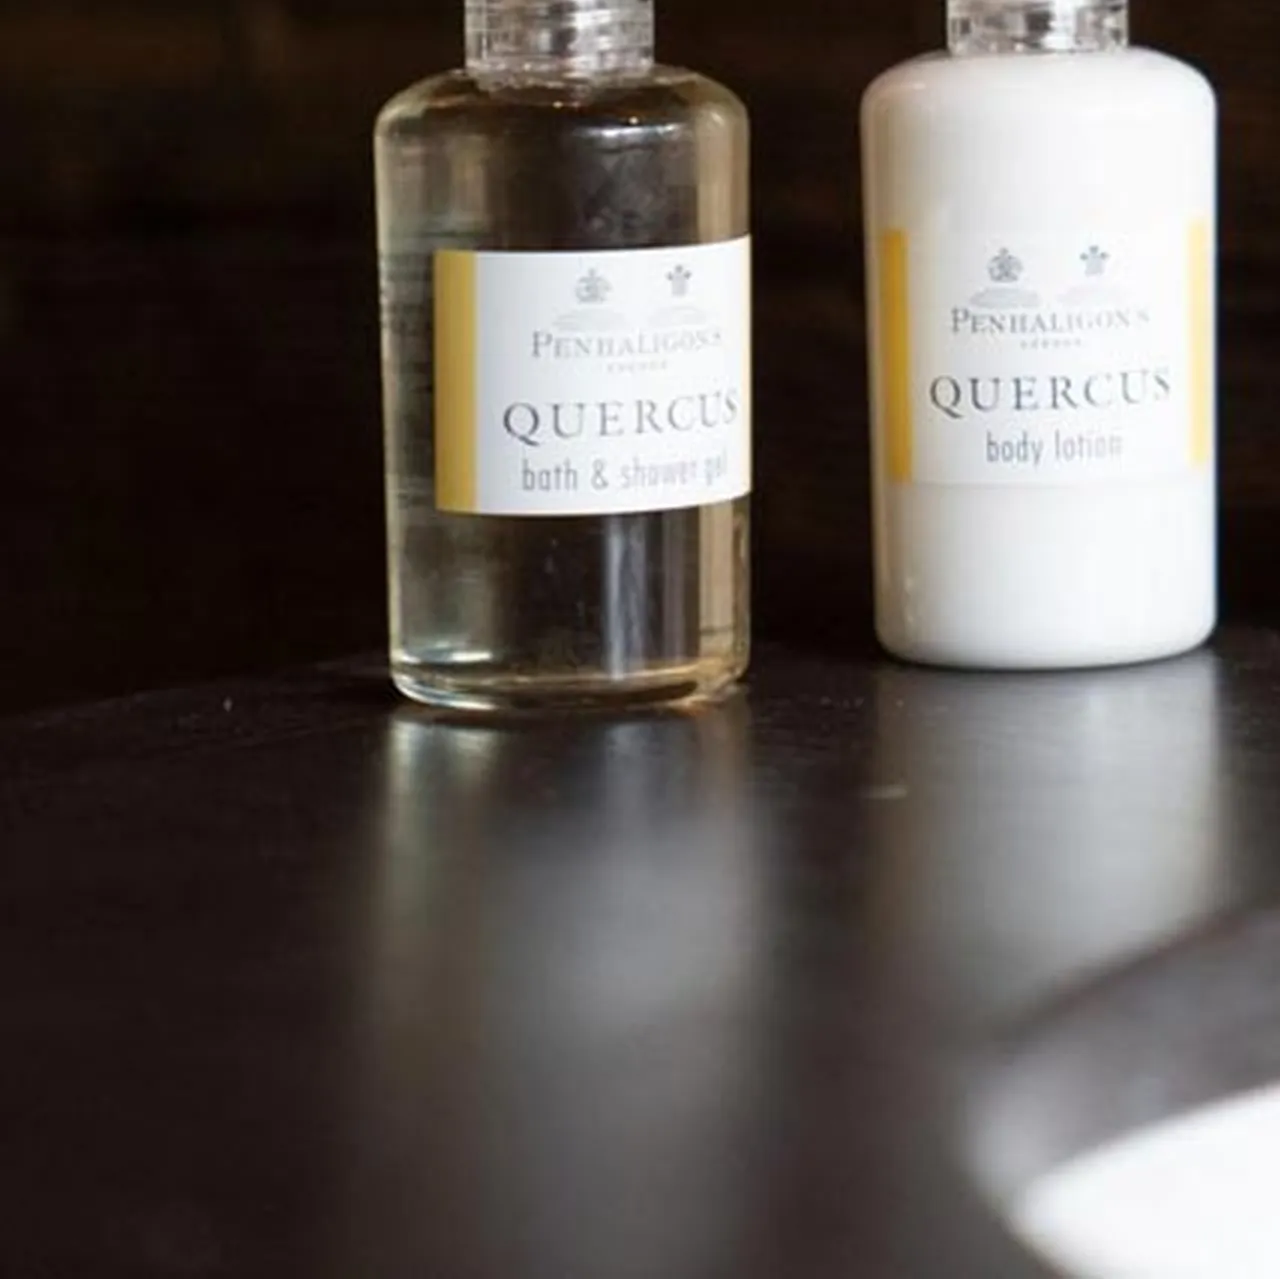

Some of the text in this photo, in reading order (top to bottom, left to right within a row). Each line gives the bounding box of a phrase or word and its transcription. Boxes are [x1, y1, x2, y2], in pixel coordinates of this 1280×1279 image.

[951, 307, 1150, 334] PENHALIGONS
[532, 328, 721, 358] PENHALIGON
[929, 367, 1171, 419] QUERCUS
[502, 388, 738, 446] QUERCUS
[986, 429, 1123, 467] body lotion
[522, 458, 578, 491] bath
[590, 458, 609, 490] &
